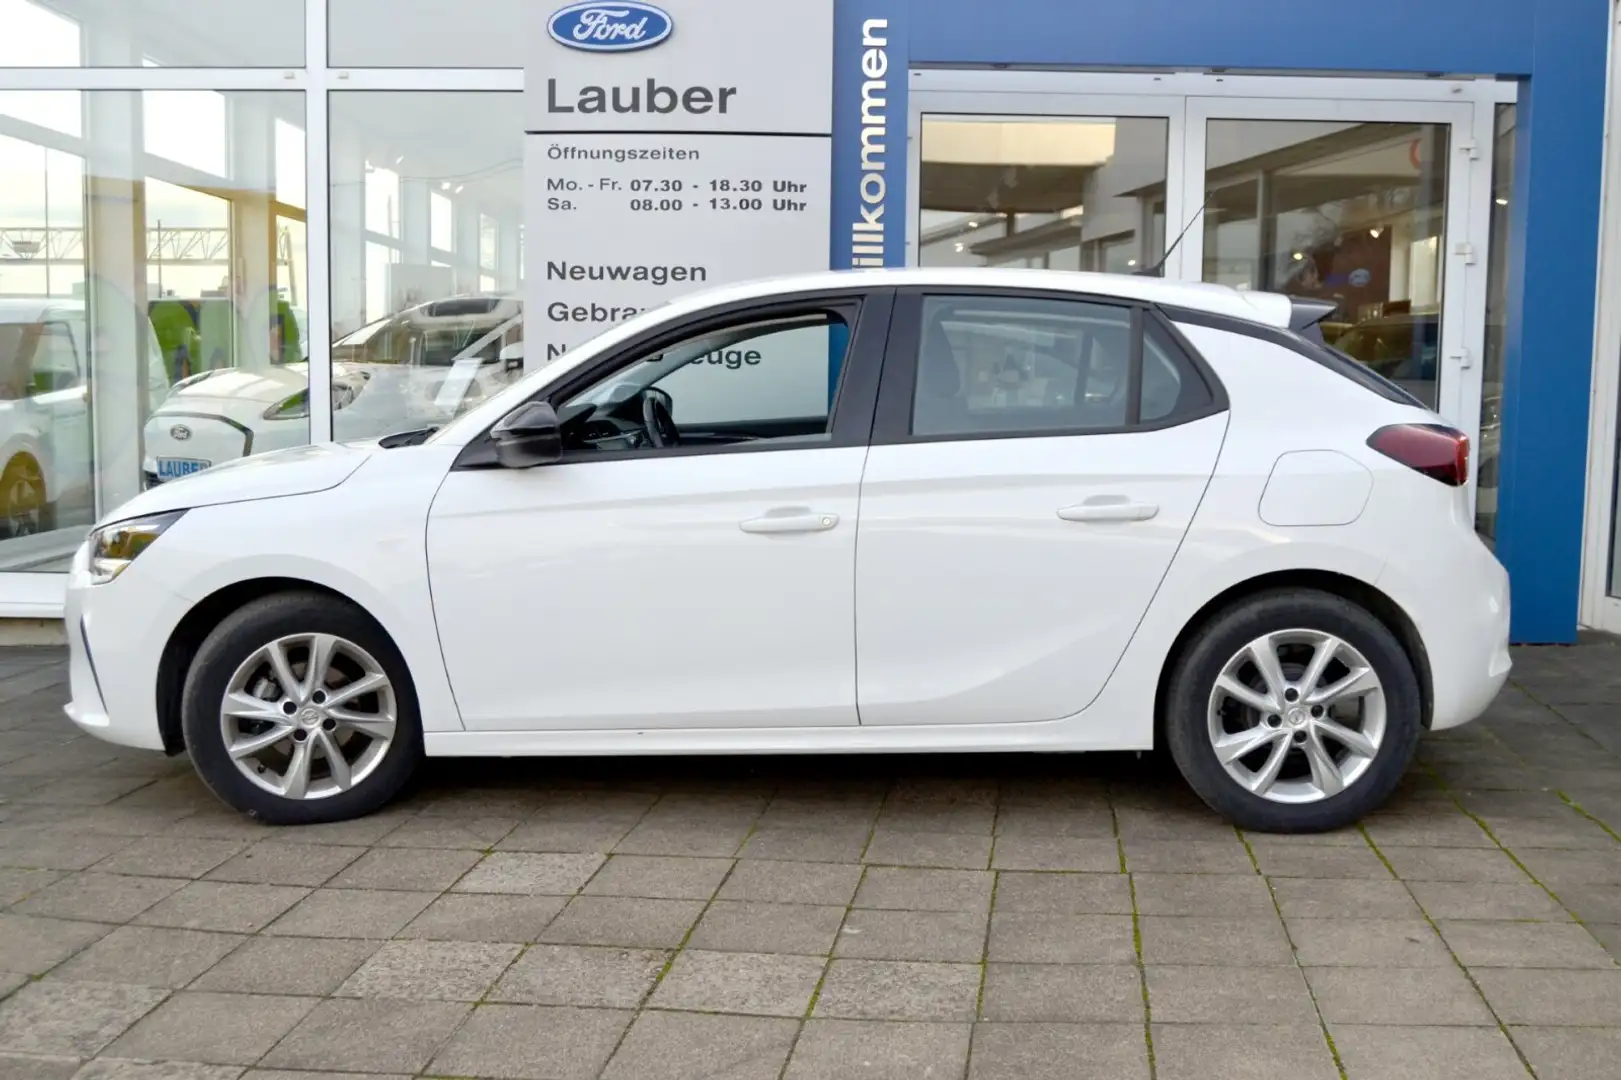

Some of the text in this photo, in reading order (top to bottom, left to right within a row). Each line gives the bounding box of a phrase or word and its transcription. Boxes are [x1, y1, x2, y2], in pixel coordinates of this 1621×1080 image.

[572, 8, 649, 40] Ford
[547, 77, 737, 115] Lauber
[547, 143, 700, 163] Öffnungszeiten
[852, 18, 888, 270] illkommen
[547, 178, 583, 191] Mo.
[599, 178, 622, 191] Fr.
[630, 179, 683, 192] 07.30
[709, 179, 763, 193] 18.30
[772, 179, 808, 193] Uhr
[547, 197, 577, 211] Sa.
[630, 198, 683, 212] 08.00
[709, 197, 763, 211] 13.00
[772, 198, 808, 212] Uhr
[547, 261, 707, 286] Neuwagen
[547, 302, 646, 322] Gebra
